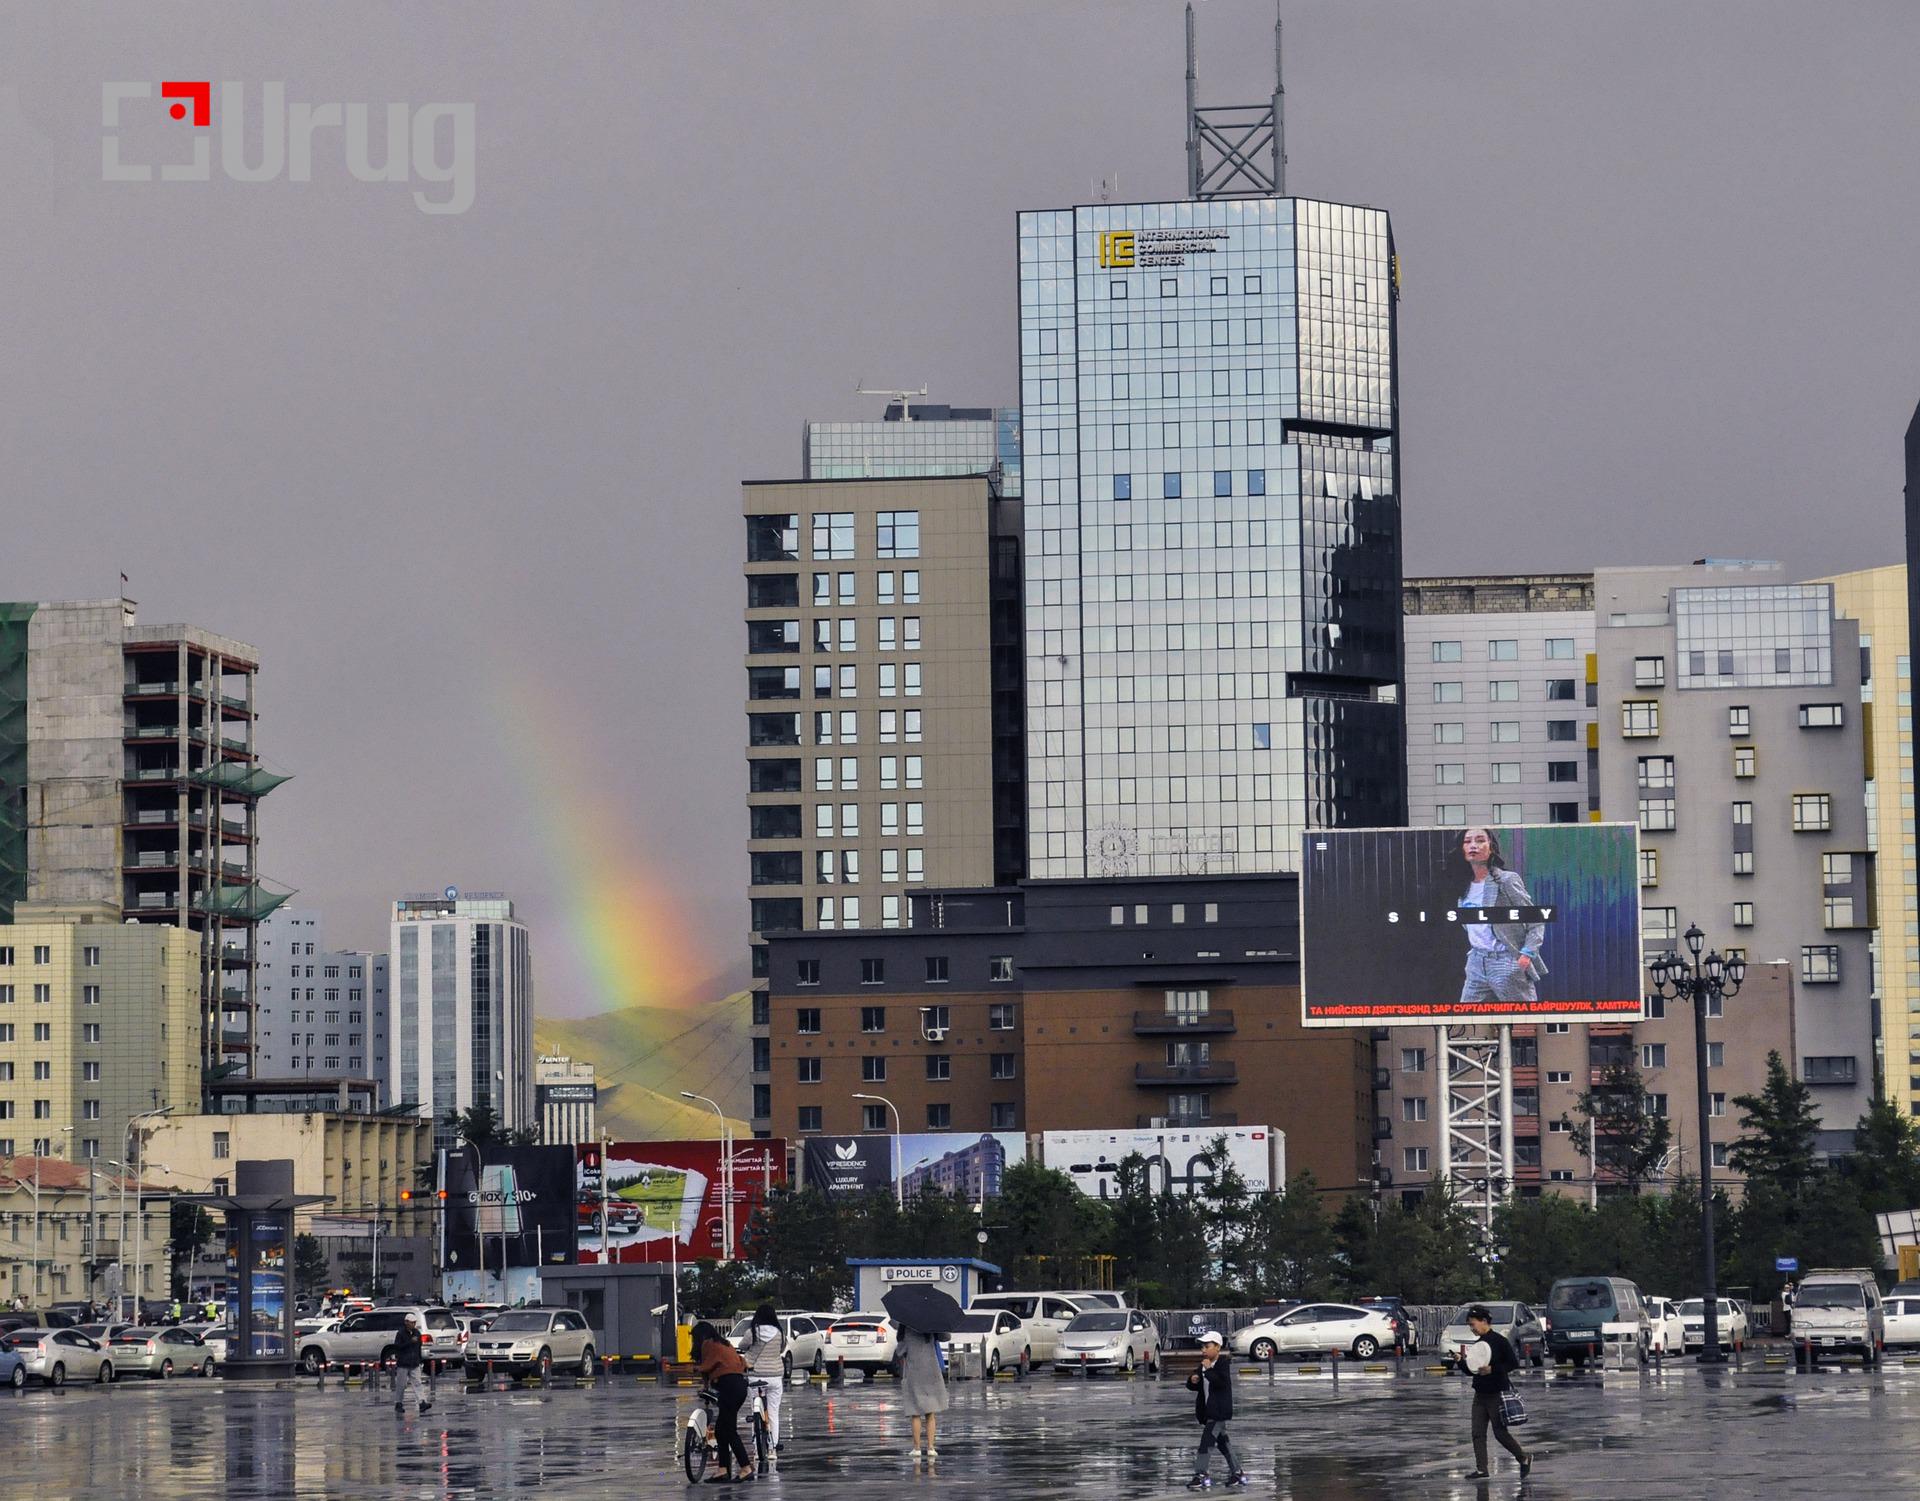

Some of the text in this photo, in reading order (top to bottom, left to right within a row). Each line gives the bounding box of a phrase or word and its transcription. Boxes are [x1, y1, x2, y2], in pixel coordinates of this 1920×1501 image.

[1138, 229, 1230, 242] INTERNATIONAL
[1138, 241, 1217, 256] COMMERCIAL
[1139, 255, 1186, 267] CENTER
[1388, 907, 1552, 923] SISLEY
[1310, 1006, 1323, 1015] ТА
[1325, 1004, 1371, 1015] НИЙСЛЭЛ
[1372, 1004, 1430, 1015] ДЭЛГЭЦЭНД
[1432, 1004, 1451, 1014] ЗАР
[1453, 1002, 1528, 1013] СУРТАЛЧИЛГАА
[896, 1269, 933, 1278] POLICE
[1188, 1326, 1206, 1335] POLICE
